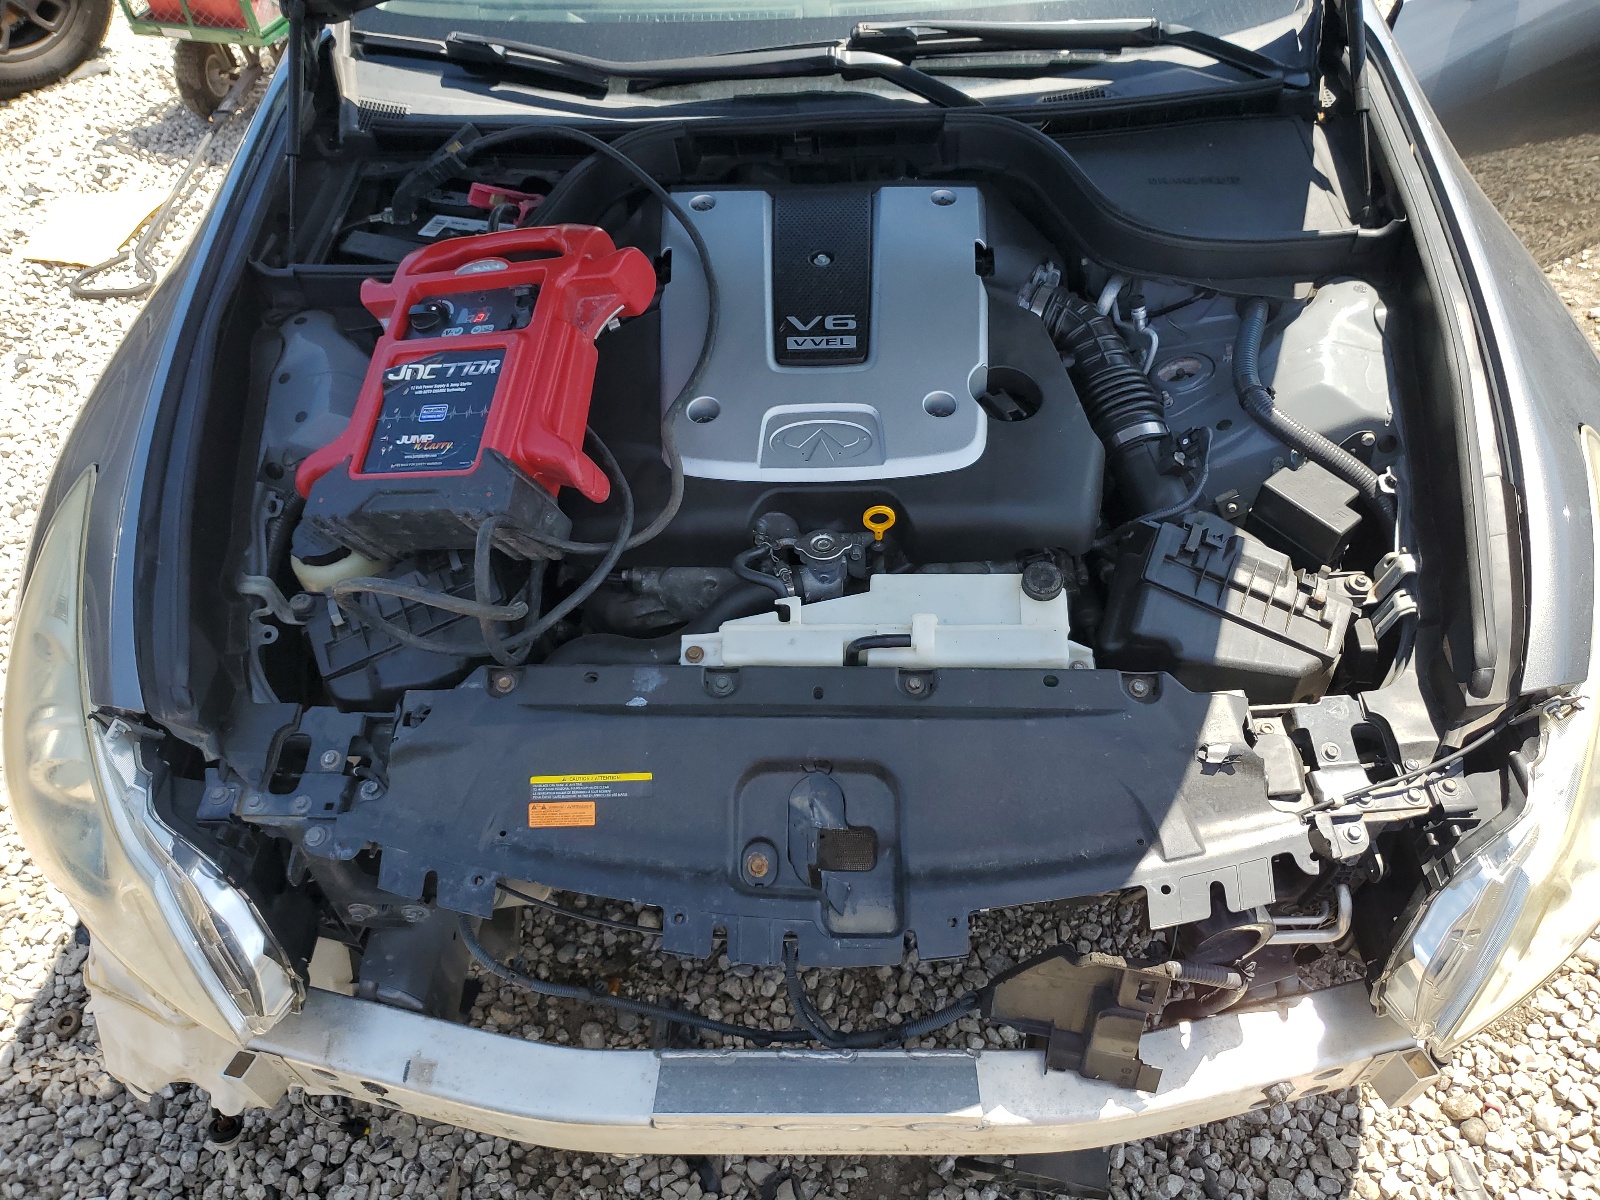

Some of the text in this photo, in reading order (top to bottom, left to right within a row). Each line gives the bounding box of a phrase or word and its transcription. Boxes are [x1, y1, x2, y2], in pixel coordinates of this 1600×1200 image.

[786, 314, 857, 331] V6
[793, 338, 851, 347] VVEL
[396, 434, 435, 445] JUMP
